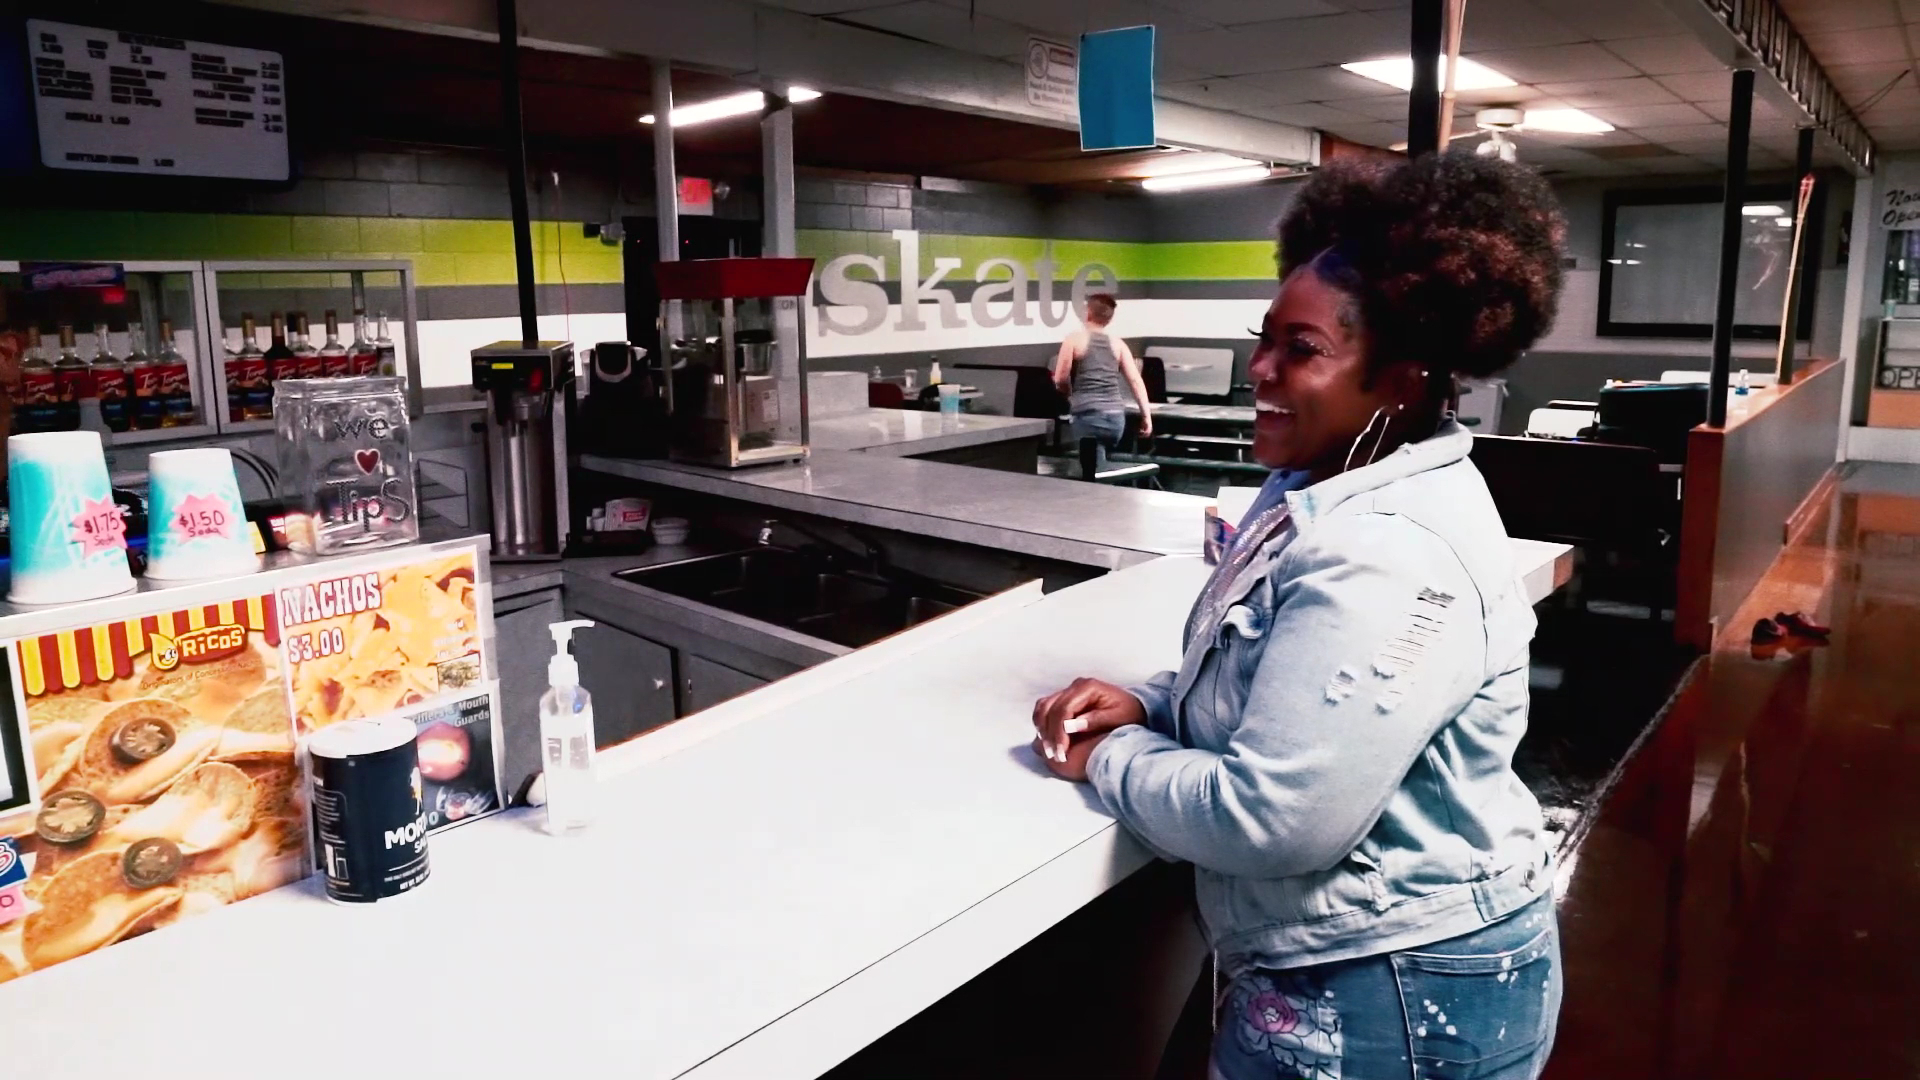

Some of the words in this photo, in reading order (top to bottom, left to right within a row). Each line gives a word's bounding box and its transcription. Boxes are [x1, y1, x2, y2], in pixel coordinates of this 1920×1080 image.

[818, 230, 1119, 337] skate
[84, 511, 120, 533] $1.75
[179, 510, 225, 528] $1.50
[281, 572, 381, 627] NACHOS
[287, 627, 344, 663] $3.00
[458, 695, 488, 710] Mouth
[454, 709, 489, 727] Guards
